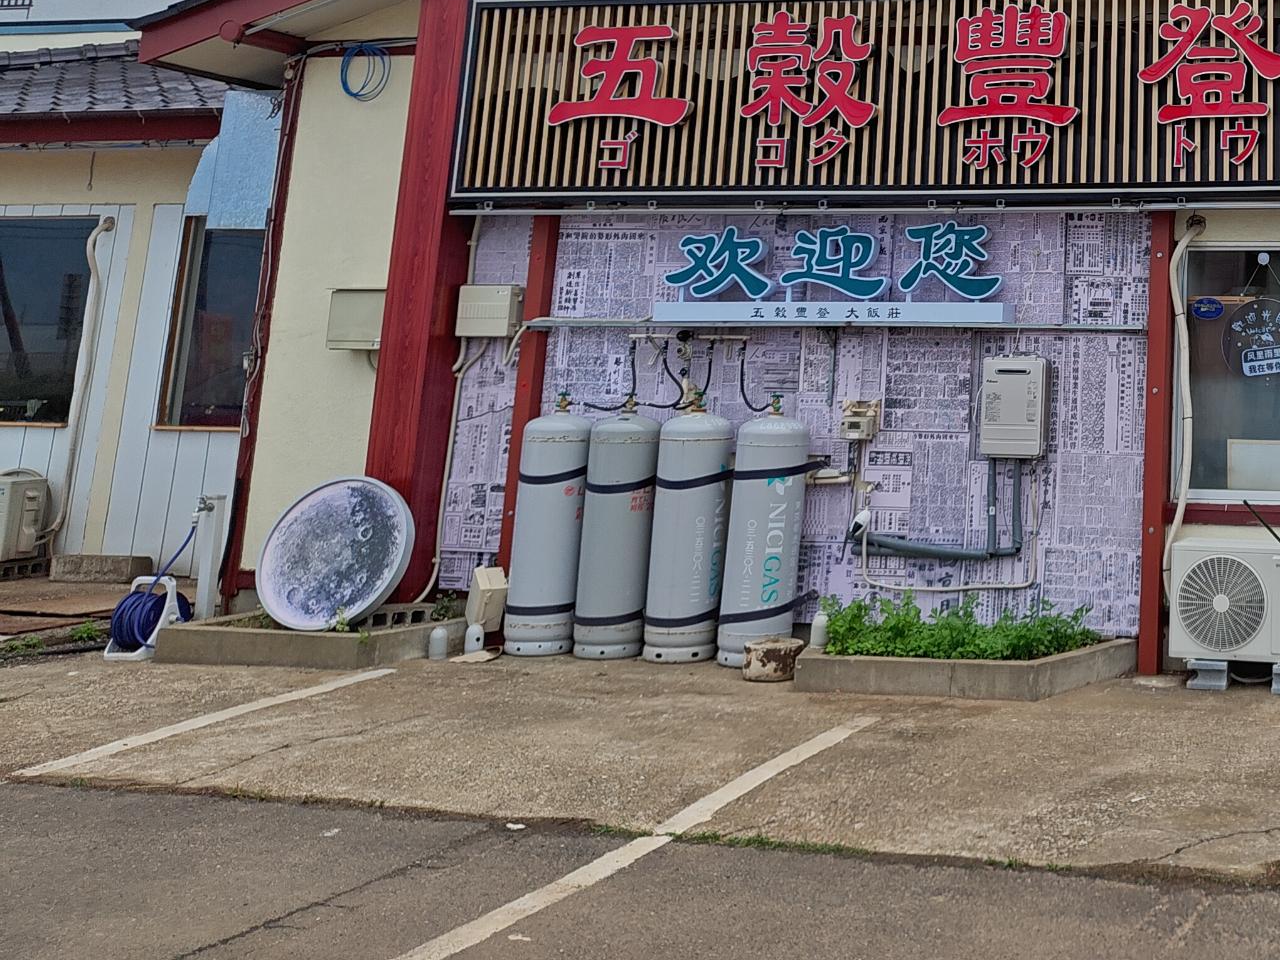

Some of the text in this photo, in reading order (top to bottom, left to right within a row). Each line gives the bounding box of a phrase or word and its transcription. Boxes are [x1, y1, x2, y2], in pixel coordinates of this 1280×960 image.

[664, 220, 1004, 300] 欢迎您
[760, 503, 787, 604] NICIGAS
